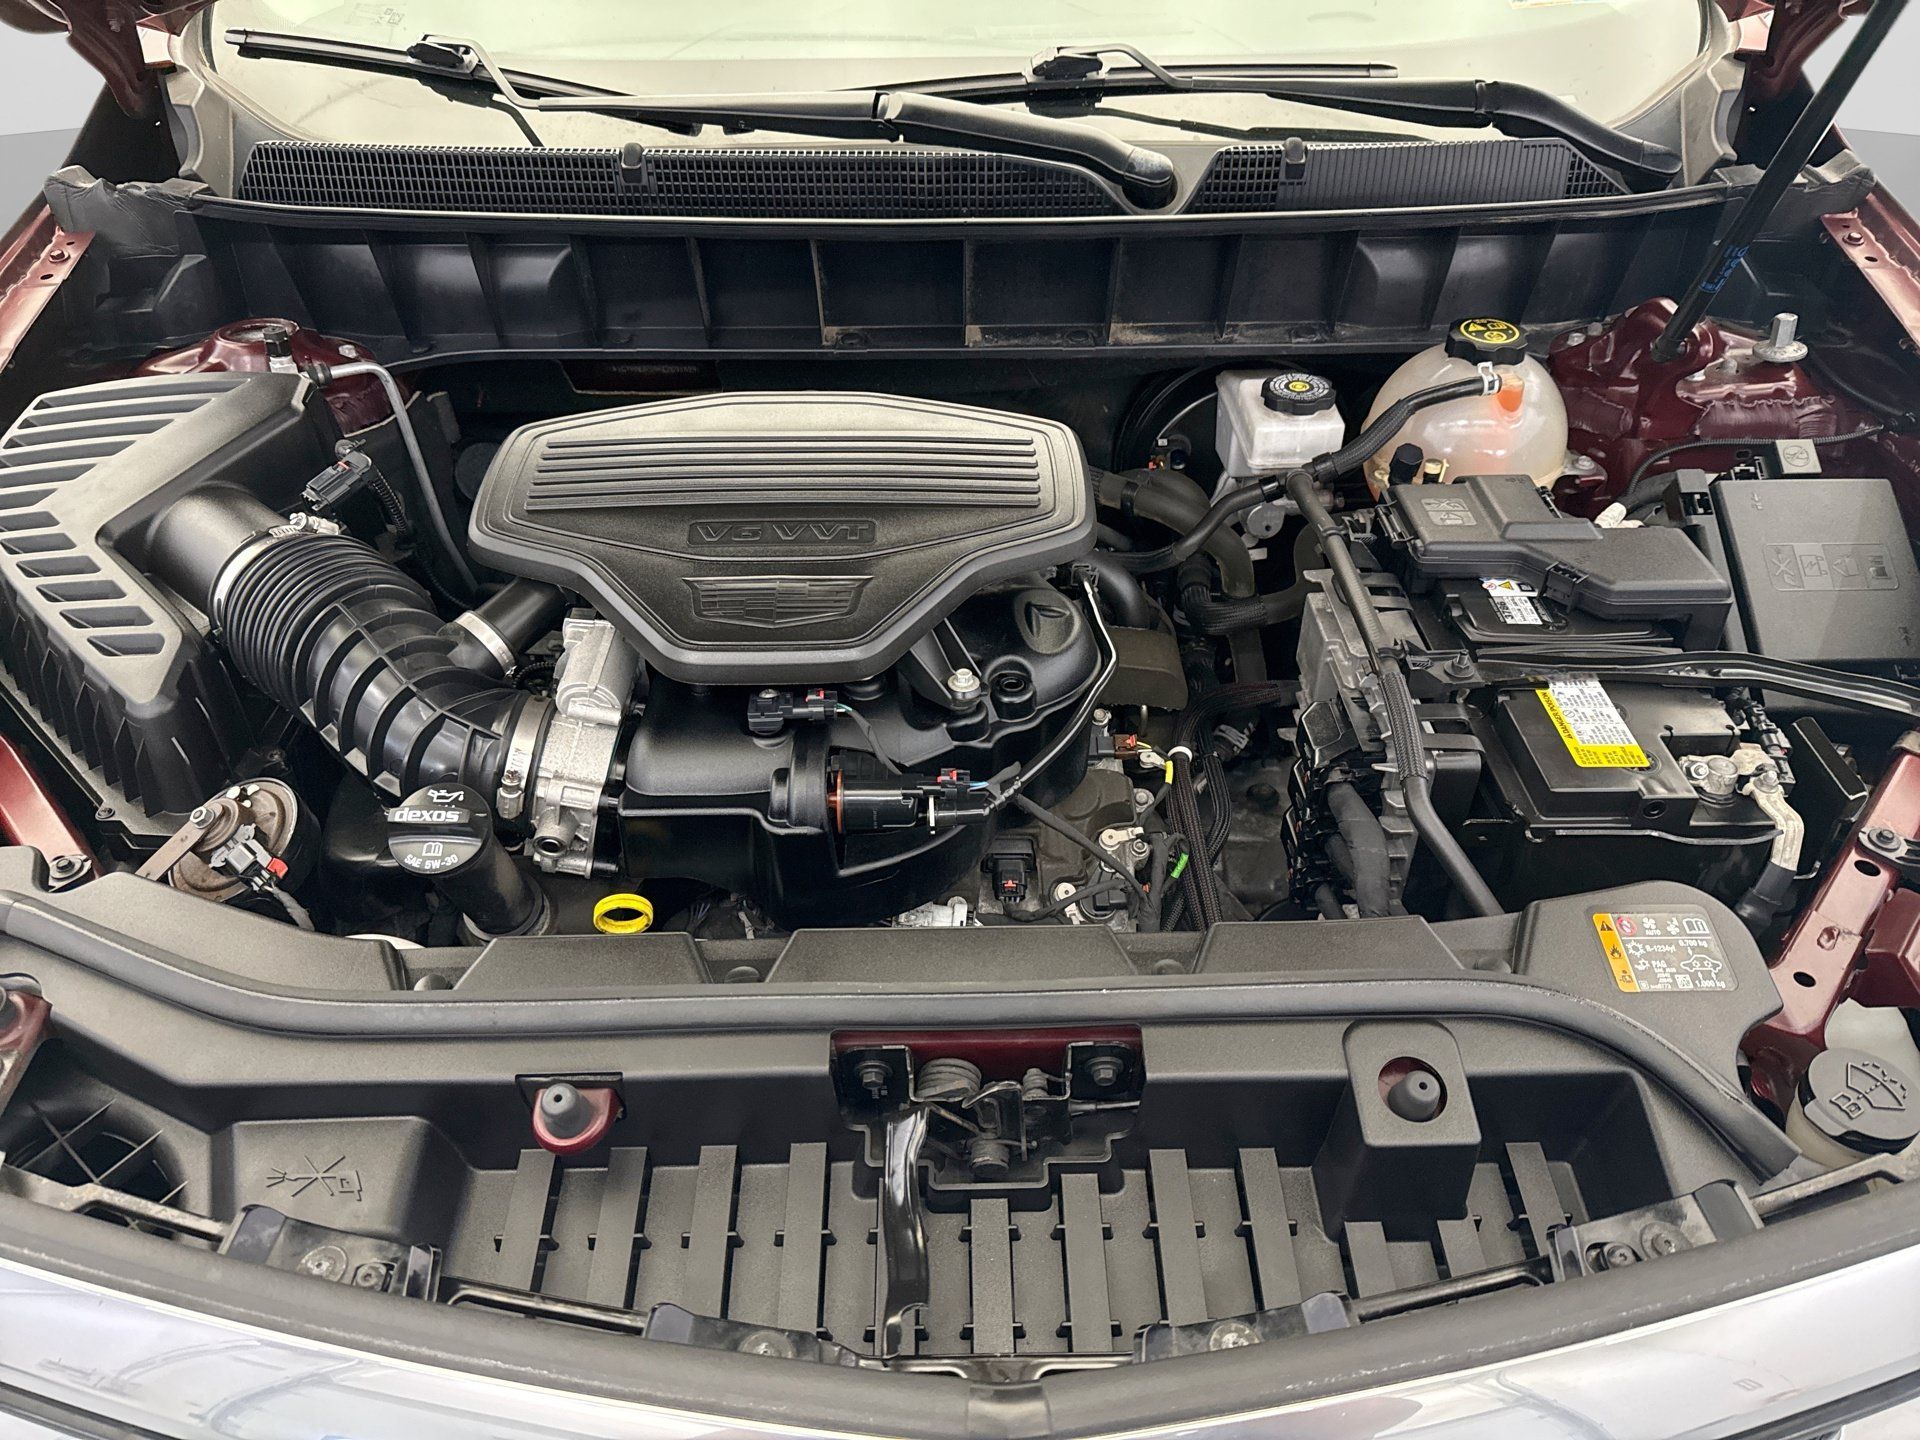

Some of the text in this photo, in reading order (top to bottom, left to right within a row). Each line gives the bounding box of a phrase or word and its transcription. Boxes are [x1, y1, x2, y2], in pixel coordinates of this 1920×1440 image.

[697, 523, 869, 541] V6 VVT
[1540, 691, 1570, 735] DANGER POISON
[394, 807, 460, 822] dexos
[404, 853, 459, 869] SAE 5W-30
[1651, 960, 1667, 968] PAG
[1715, 979, 1726, 989] kg
